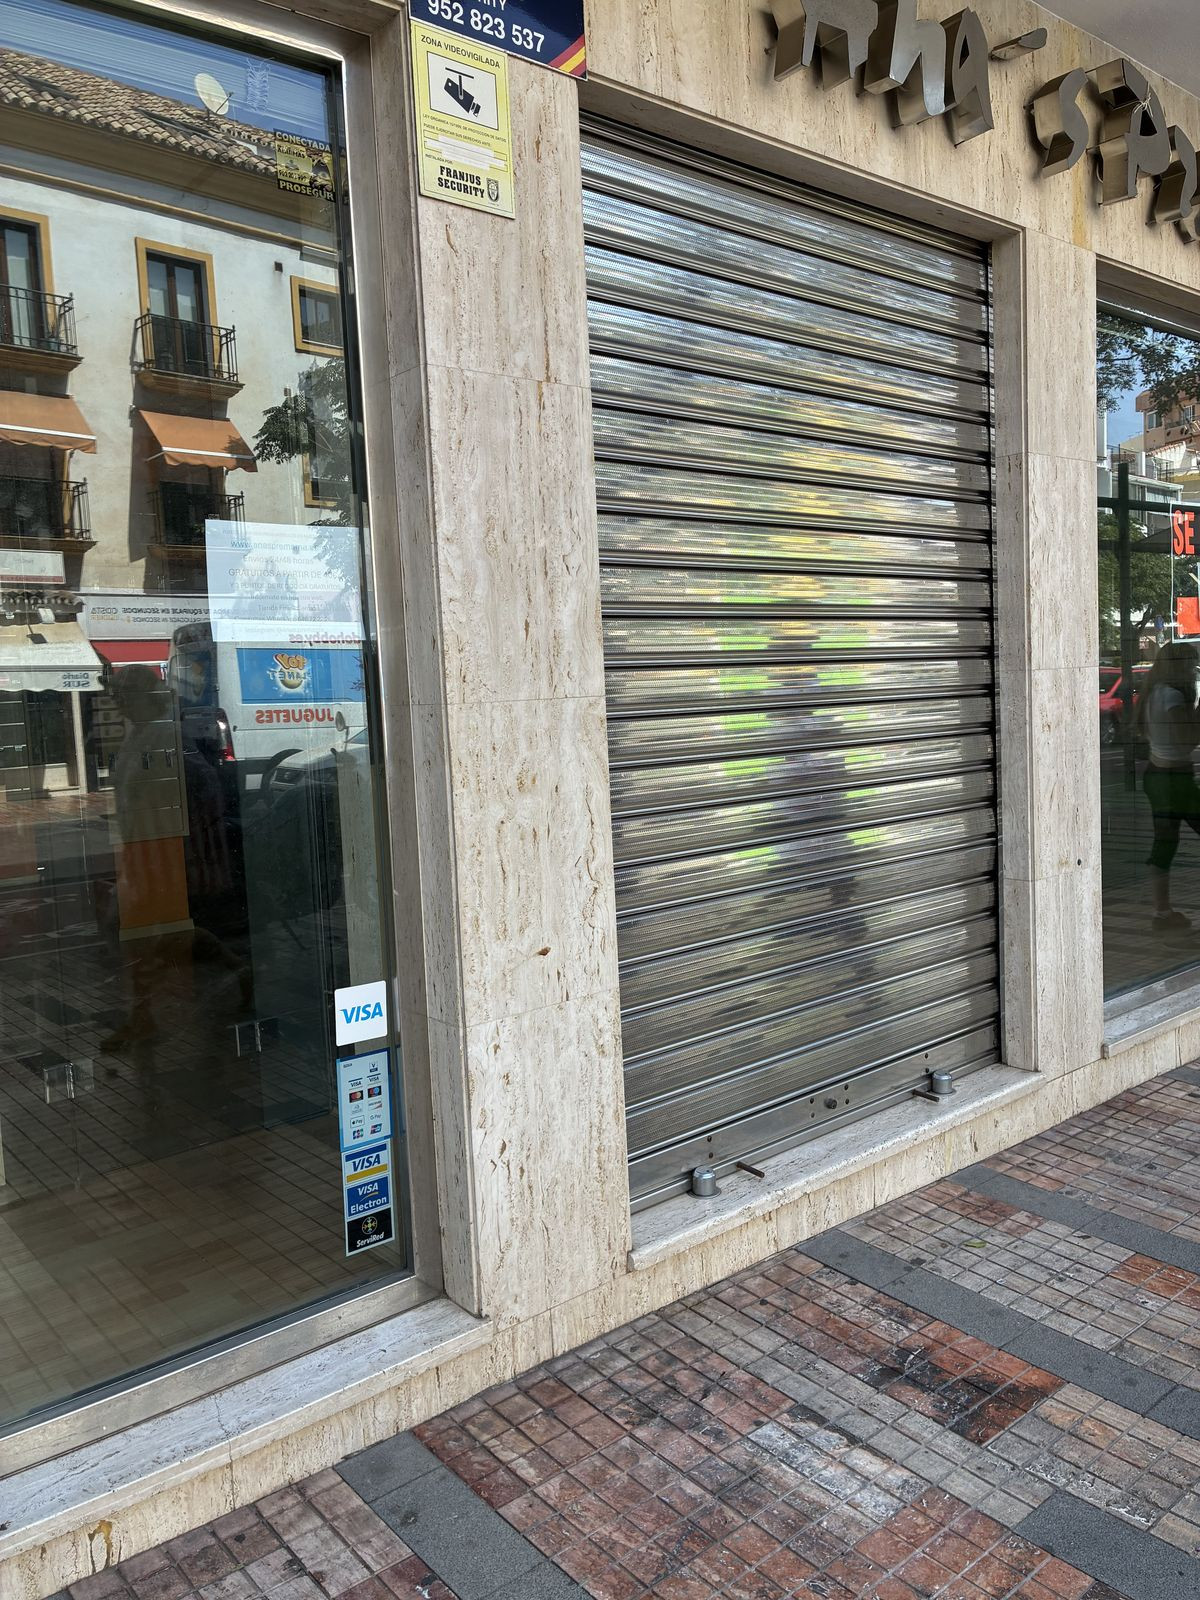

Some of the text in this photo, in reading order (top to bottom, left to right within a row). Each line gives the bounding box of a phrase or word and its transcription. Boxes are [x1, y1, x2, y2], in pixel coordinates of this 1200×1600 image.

[428, 0, 545, 53] 952 823 537
[421, 34, 501, 68] ZONA VIDEOVIGILADA
[275, 131, 331, 153] CONECTADA
[439, 165, 482, 186] FRANJUS
[279, 180, 334, 200] PROSEGUR
[437, 177, 485, 199] SECURITY
[1172, 509, 1195, 556] SE
[228, 568, 274, 577] GRATUITOS
[340, 1001, 384, 1025] VISA
[350, 1080, 362, 1088] VISA
[368, 1075, 380, 1083] VISA
[352, 1153, 381, 1172] VISA
[357, 1182, 379, 1196] VISA
[350, 1196, 387, 1214] Electron
[356, 1232, 385, 1248] ServiRed
